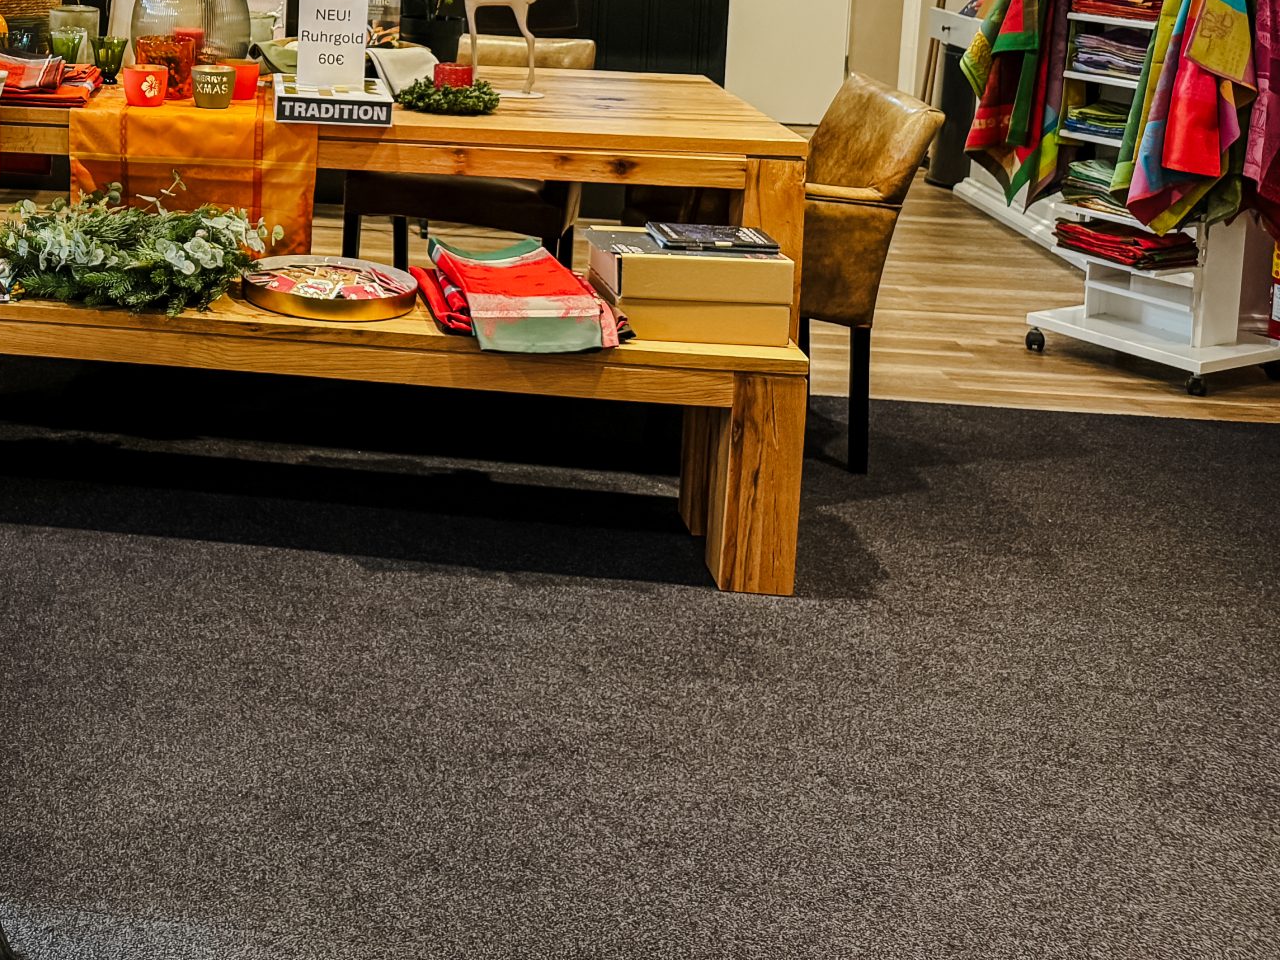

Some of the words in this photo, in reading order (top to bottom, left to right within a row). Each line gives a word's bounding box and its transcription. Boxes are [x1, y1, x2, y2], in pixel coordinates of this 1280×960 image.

[316, 9, 351, 21] NEU!
[301, 30, 364, 45] Ruhrgold
[318, 54, 344, 66] 60€
[196, 82, 228, 95] XMAS
[281, 101, 387, 121] TRADITION
